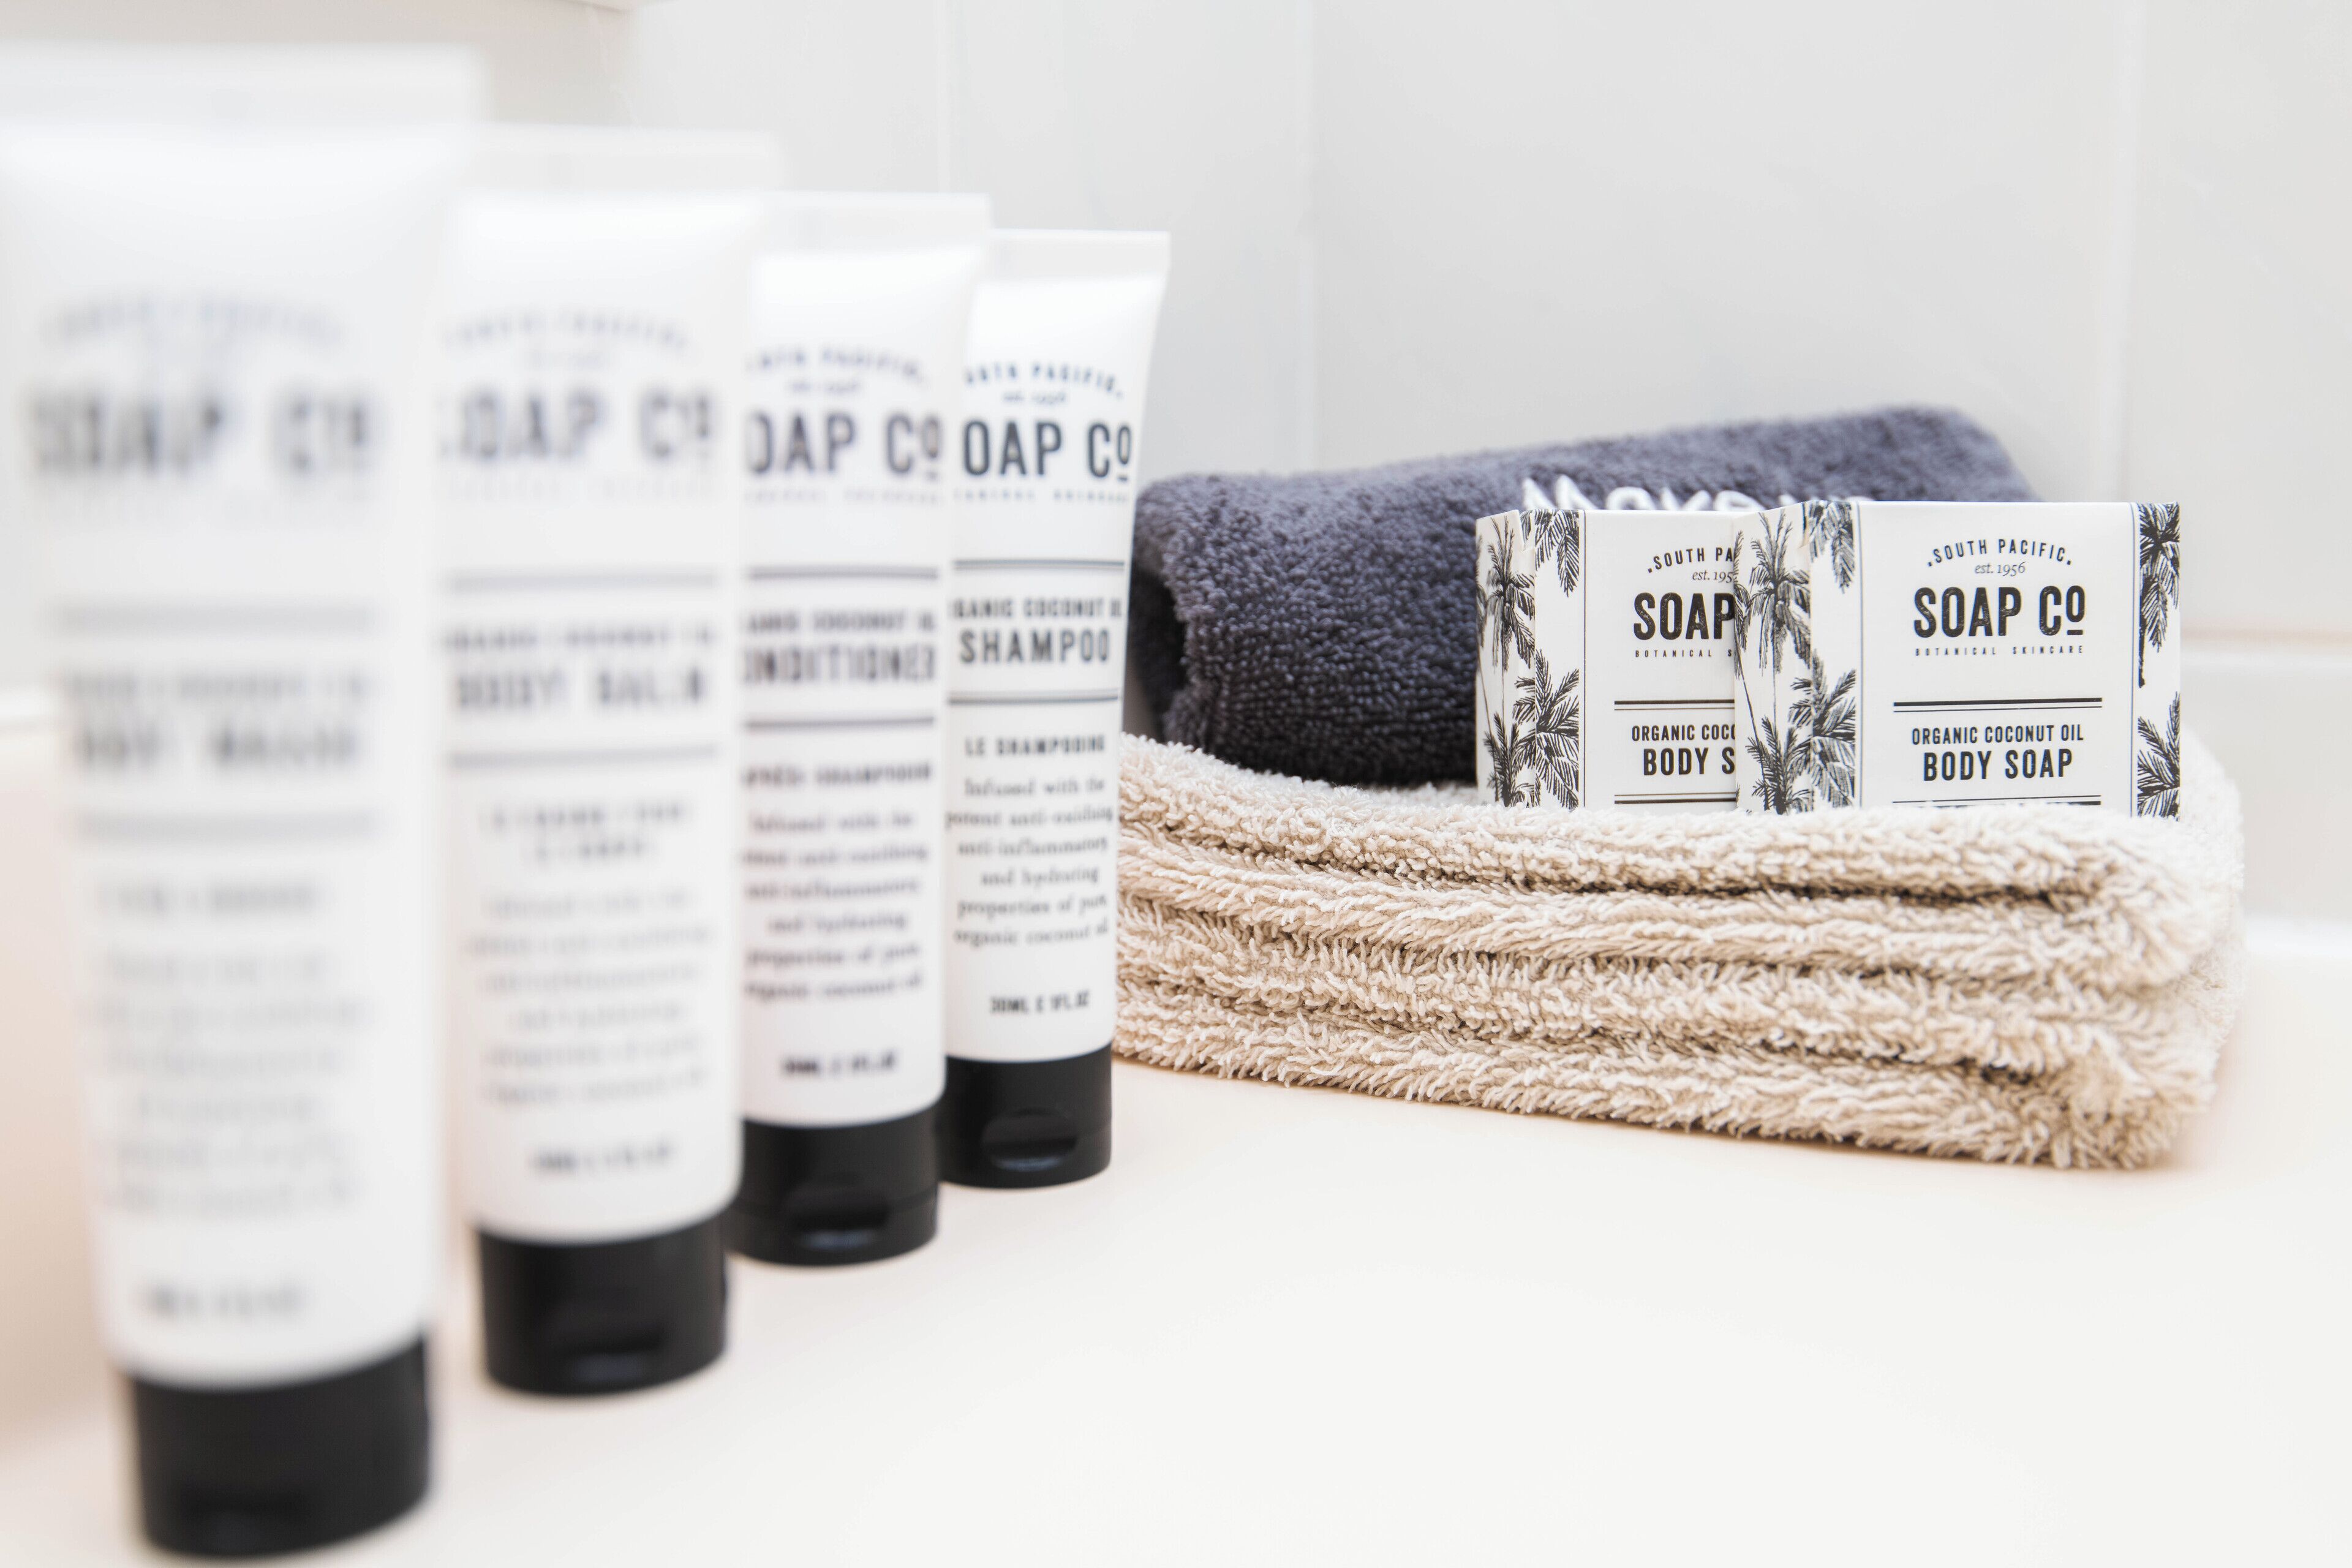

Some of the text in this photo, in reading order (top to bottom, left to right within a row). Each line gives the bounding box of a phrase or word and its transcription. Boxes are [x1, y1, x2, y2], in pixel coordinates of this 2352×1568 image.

[963, 420, 1062, 476] OAP
[1692, 570, 1733, 583] est. 195
[1975, 562, 2026, 576] est. 1956
[1634, 592, 1735, 640] SOAP
[1913, 587, 2021, 638] SOAP
[960, 628, 1109, 663] SHAMPOO
[1915, 646, 2082, 656] BOTANICAL SKINCARE
[1632, 725, 1695, 741] ORGANIC
[1912, 724, 2084, 745] ORGANIC COCONUT OIL
[1643, 747, 1708, 775] BODY
[1923, 748, 2072, 781] BODY SOAP
